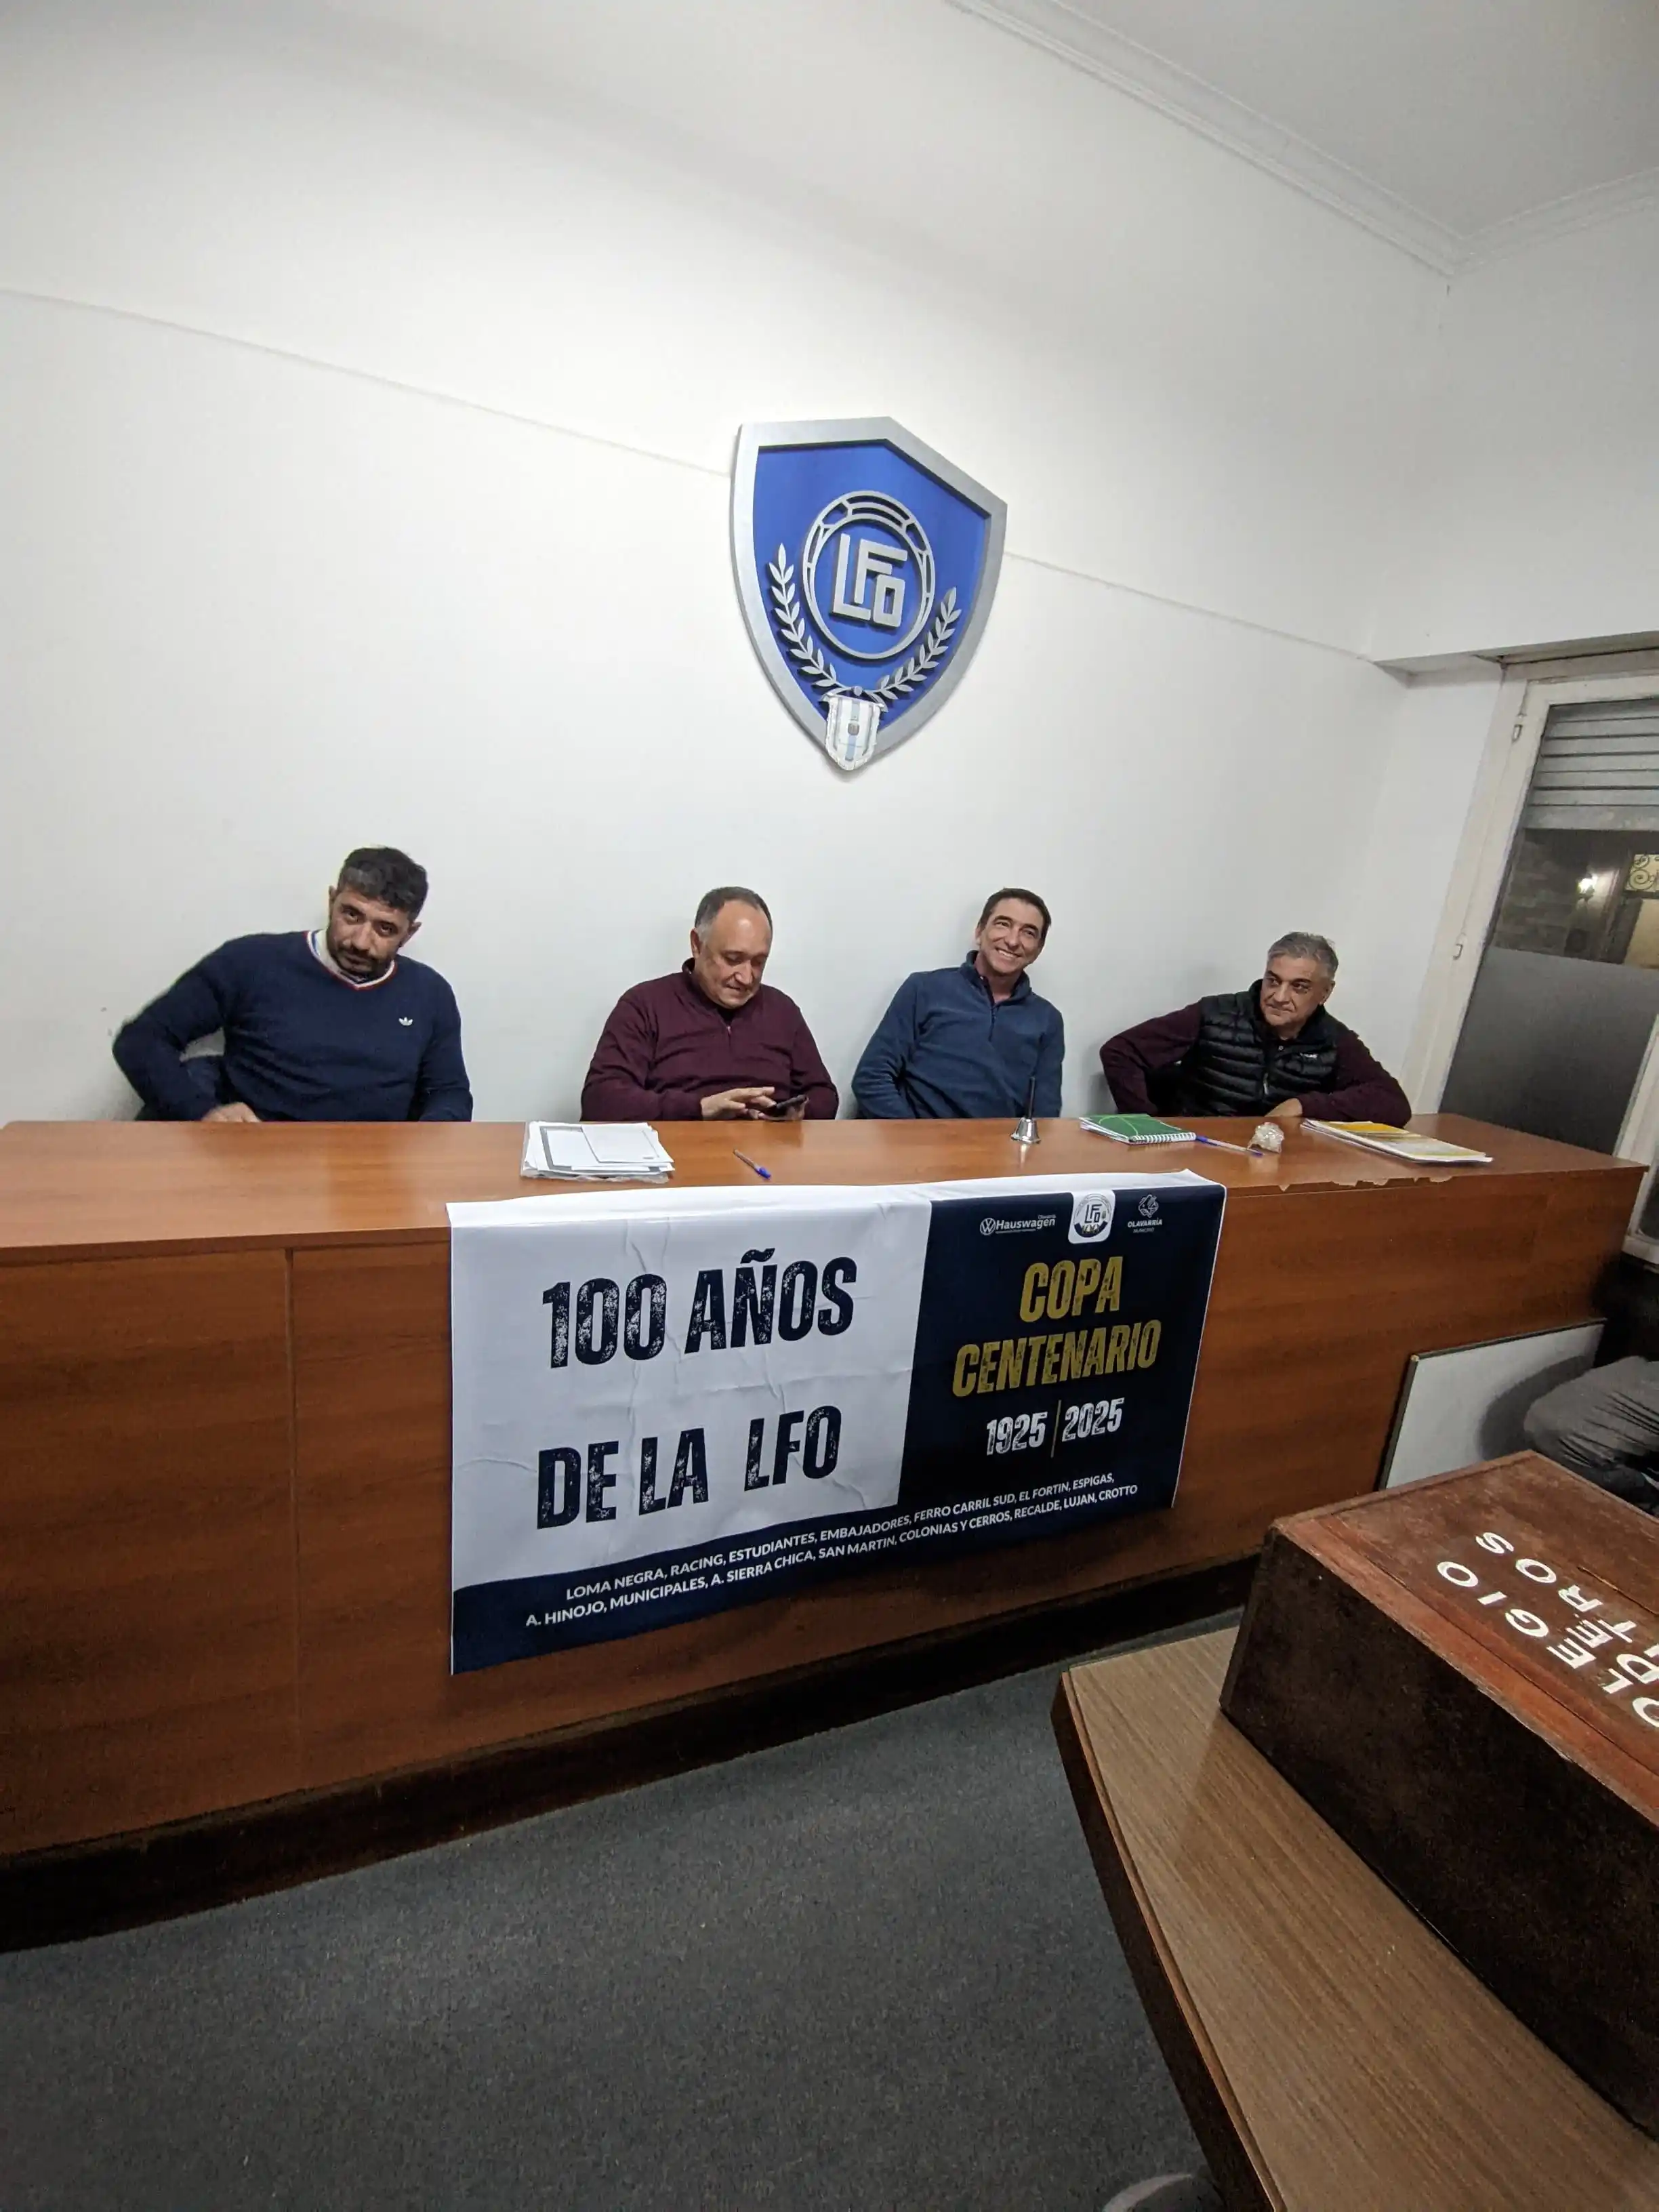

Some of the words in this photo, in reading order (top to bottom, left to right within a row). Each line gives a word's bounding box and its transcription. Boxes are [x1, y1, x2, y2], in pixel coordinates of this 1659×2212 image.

[996, 1218, 1055, 1229] Hauswagen
[541, 1273, 667, 1368] 100
[684, 1248, 857, 1354] AÑOS
[1019, 1256, 1124, 1323] COPA
[952, 1319, 1162, 1397] CENTENARIO
[537, 1441, 619, 1529] DE
[638, 1427, 709, 1516] LA
[743, 1406, 842, 1492] LFO
[986, 1412, 1048, 1456] 1925
[1062, 1397, 1125, 1442] 2025
[525, 1614, 541, 1626] A.
[544, 1601, 607, 1624] HINOJO,
[610, 1578, 708, 1610] MUNICIPALES,
[710, 1574, 724, 1586] A.
[726, 1563, 773, 1582] SIERRA
[775, 1549, 817, 1570] CHICA,
[819, 1545, 845, 1559] SAN
[847, 1534, 898, 1555] MARTIN,
[899, 1523, 958, 1543] COLONIAS
[960, 1519, 968, 1531] Y
[969, 1511, 1012, 1530] CERROS,
[1015, 1501, 1062, 1519] RECALDE,
[1063, 1492, 1097, 1509] LUJAN,
[1099, 1484, 1138, 1501] CROTTO
[566, 1581, 611, 1600] LOMA
[614, 1569, 668, 1589] NEGRA,
[670, 1553, 726, 1576] RACING,
[729, 1532, 817, 1563] ESTUDIANTES,
[820, 1515, 912, 1541] EMBAJADORES,
[914, 1506, 951, 1523] FERRO
[953, 1498, 991, 1515] CARRIL
[993, 1493, 1017, 1507] SUD,
[1019, 1490, 1030, 1501] EL
[1032, 1481, 1071, 1498] FORTIN,
[1073, 1473, 1115, 1490] ESPIGAS,
